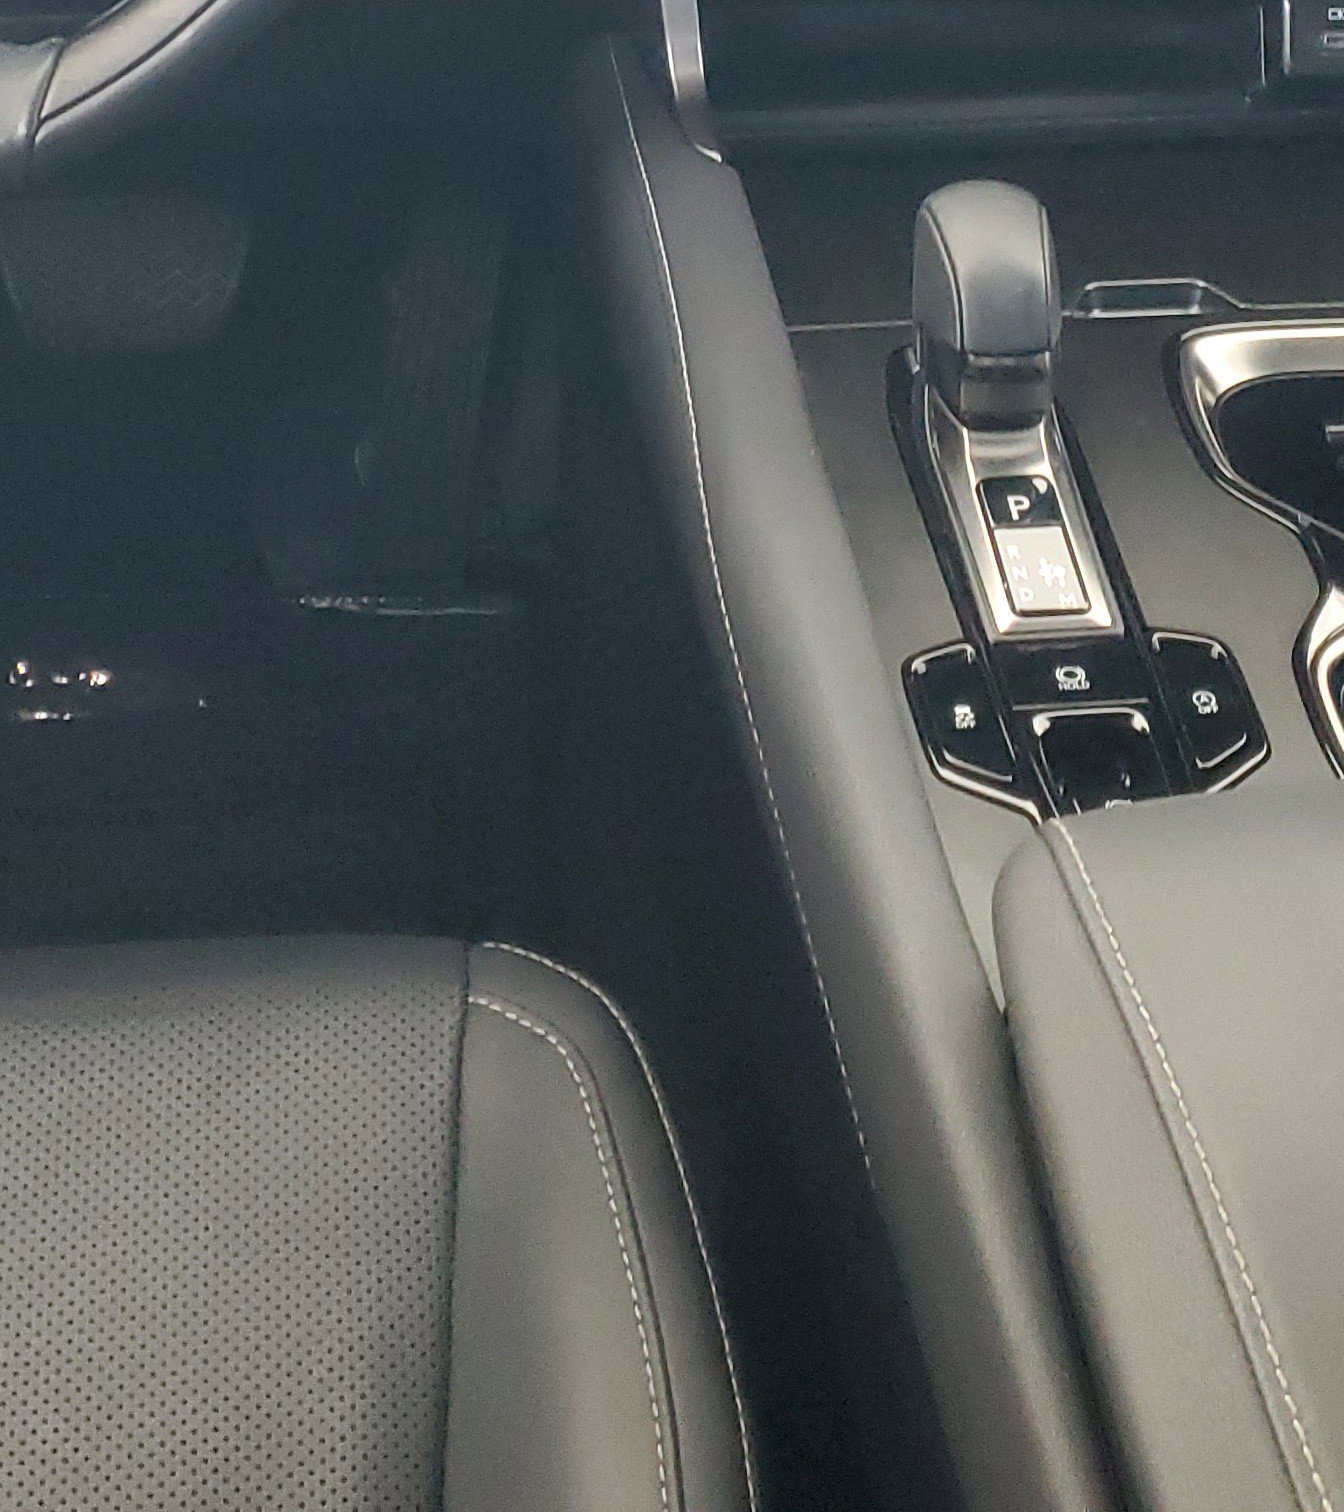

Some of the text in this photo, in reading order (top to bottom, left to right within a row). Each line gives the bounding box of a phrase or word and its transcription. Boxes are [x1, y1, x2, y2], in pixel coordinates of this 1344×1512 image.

[1006, 494, 1031, 521] P
[1011, 564, 1029, 581] N
[1018, 587, 1035, 602] D
[1058, 592, 1077, 606] M
